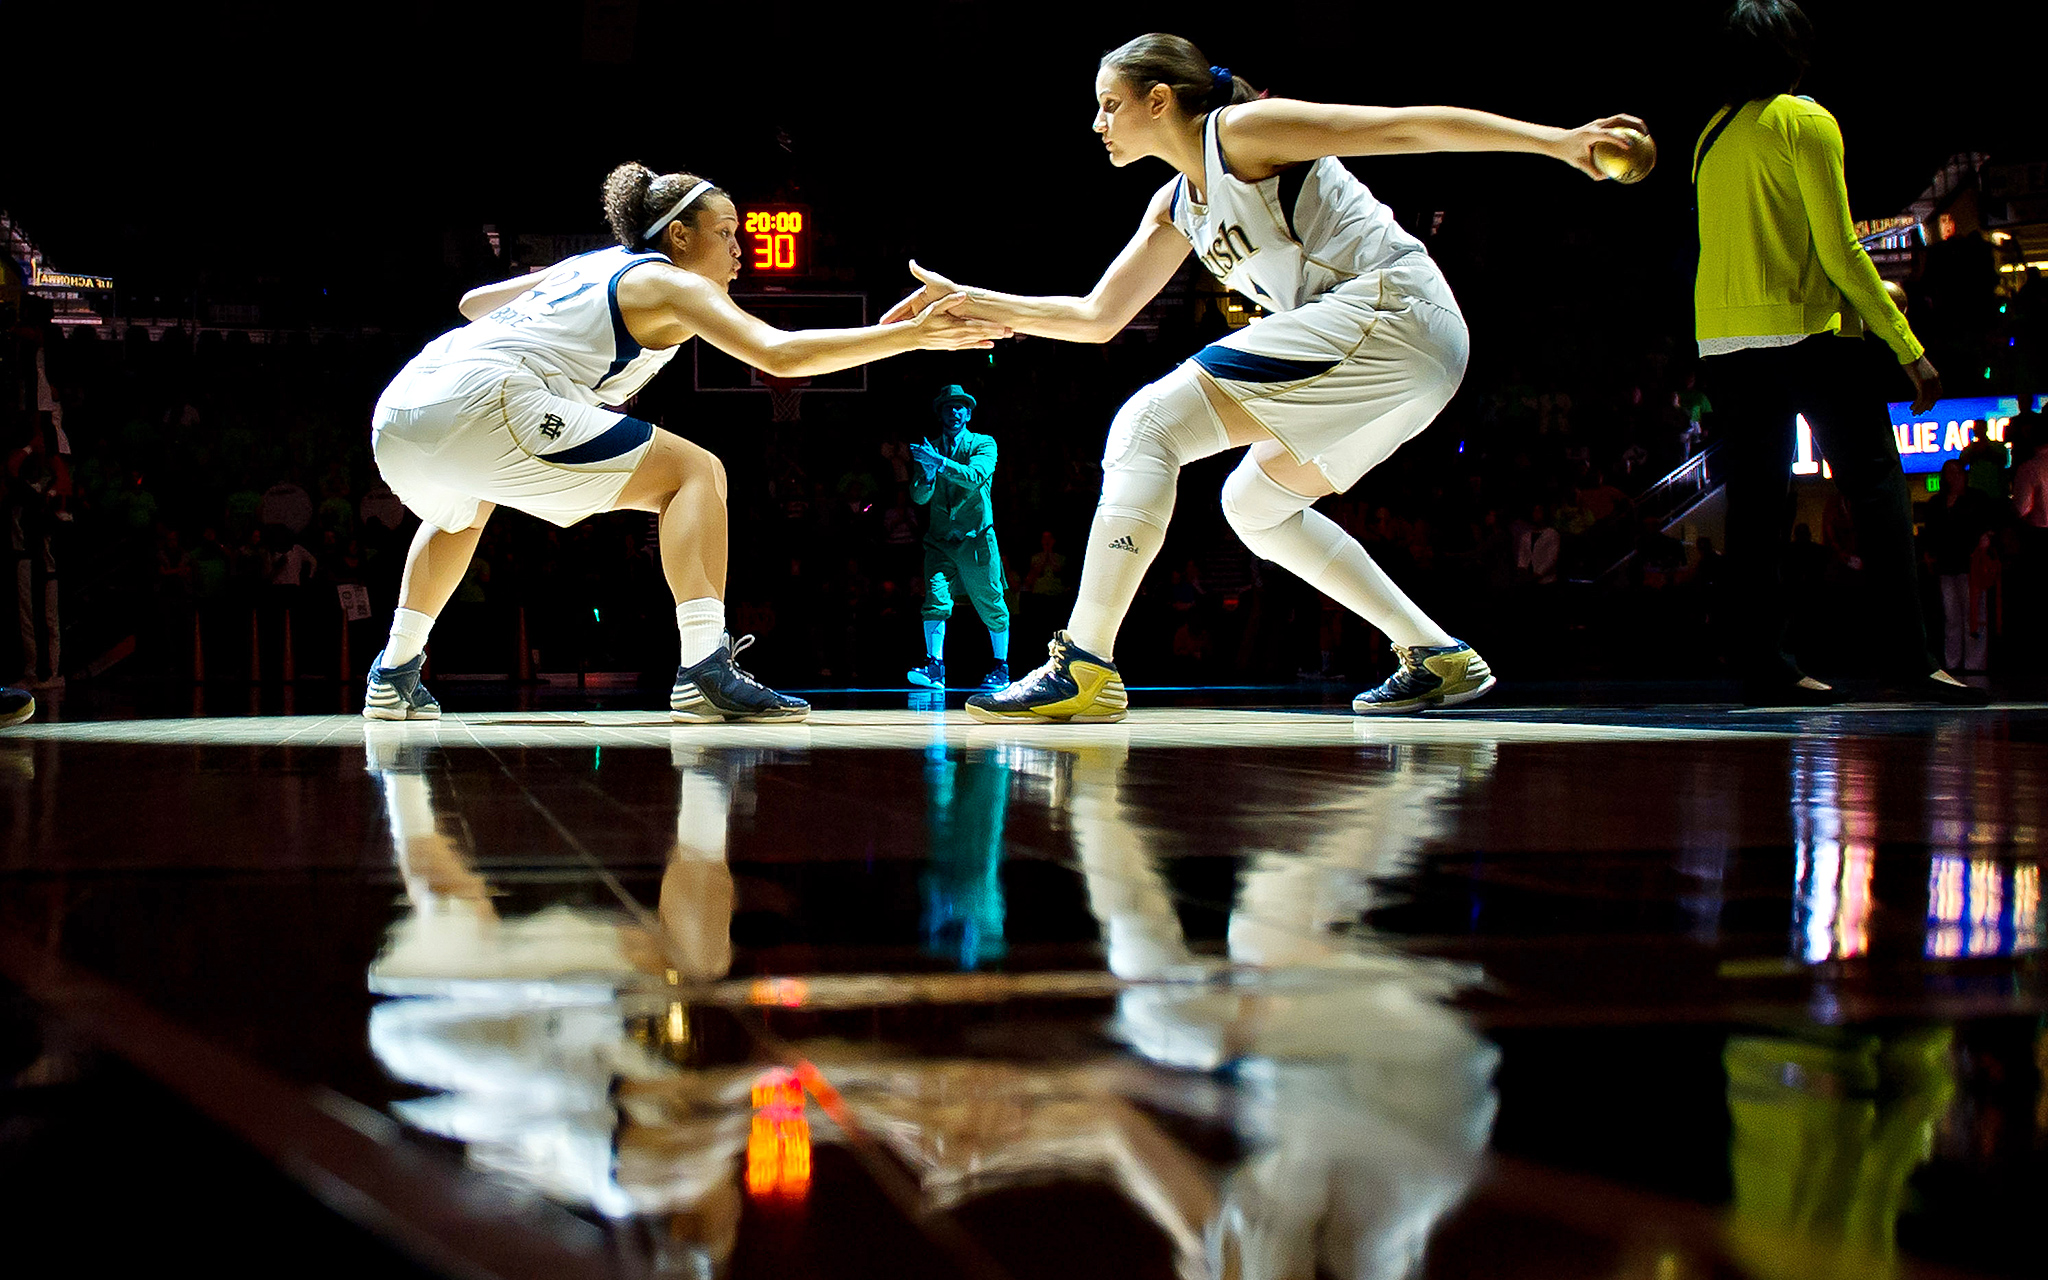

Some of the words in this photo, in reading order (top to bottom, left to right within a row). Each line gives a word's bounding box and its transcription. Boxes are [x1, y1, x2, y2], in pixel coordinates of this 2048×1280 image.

[745, 211, 802, 233] 20:00
[755, 234, 795, 268] 30
[1108, 542, 1139, 555] adidas
